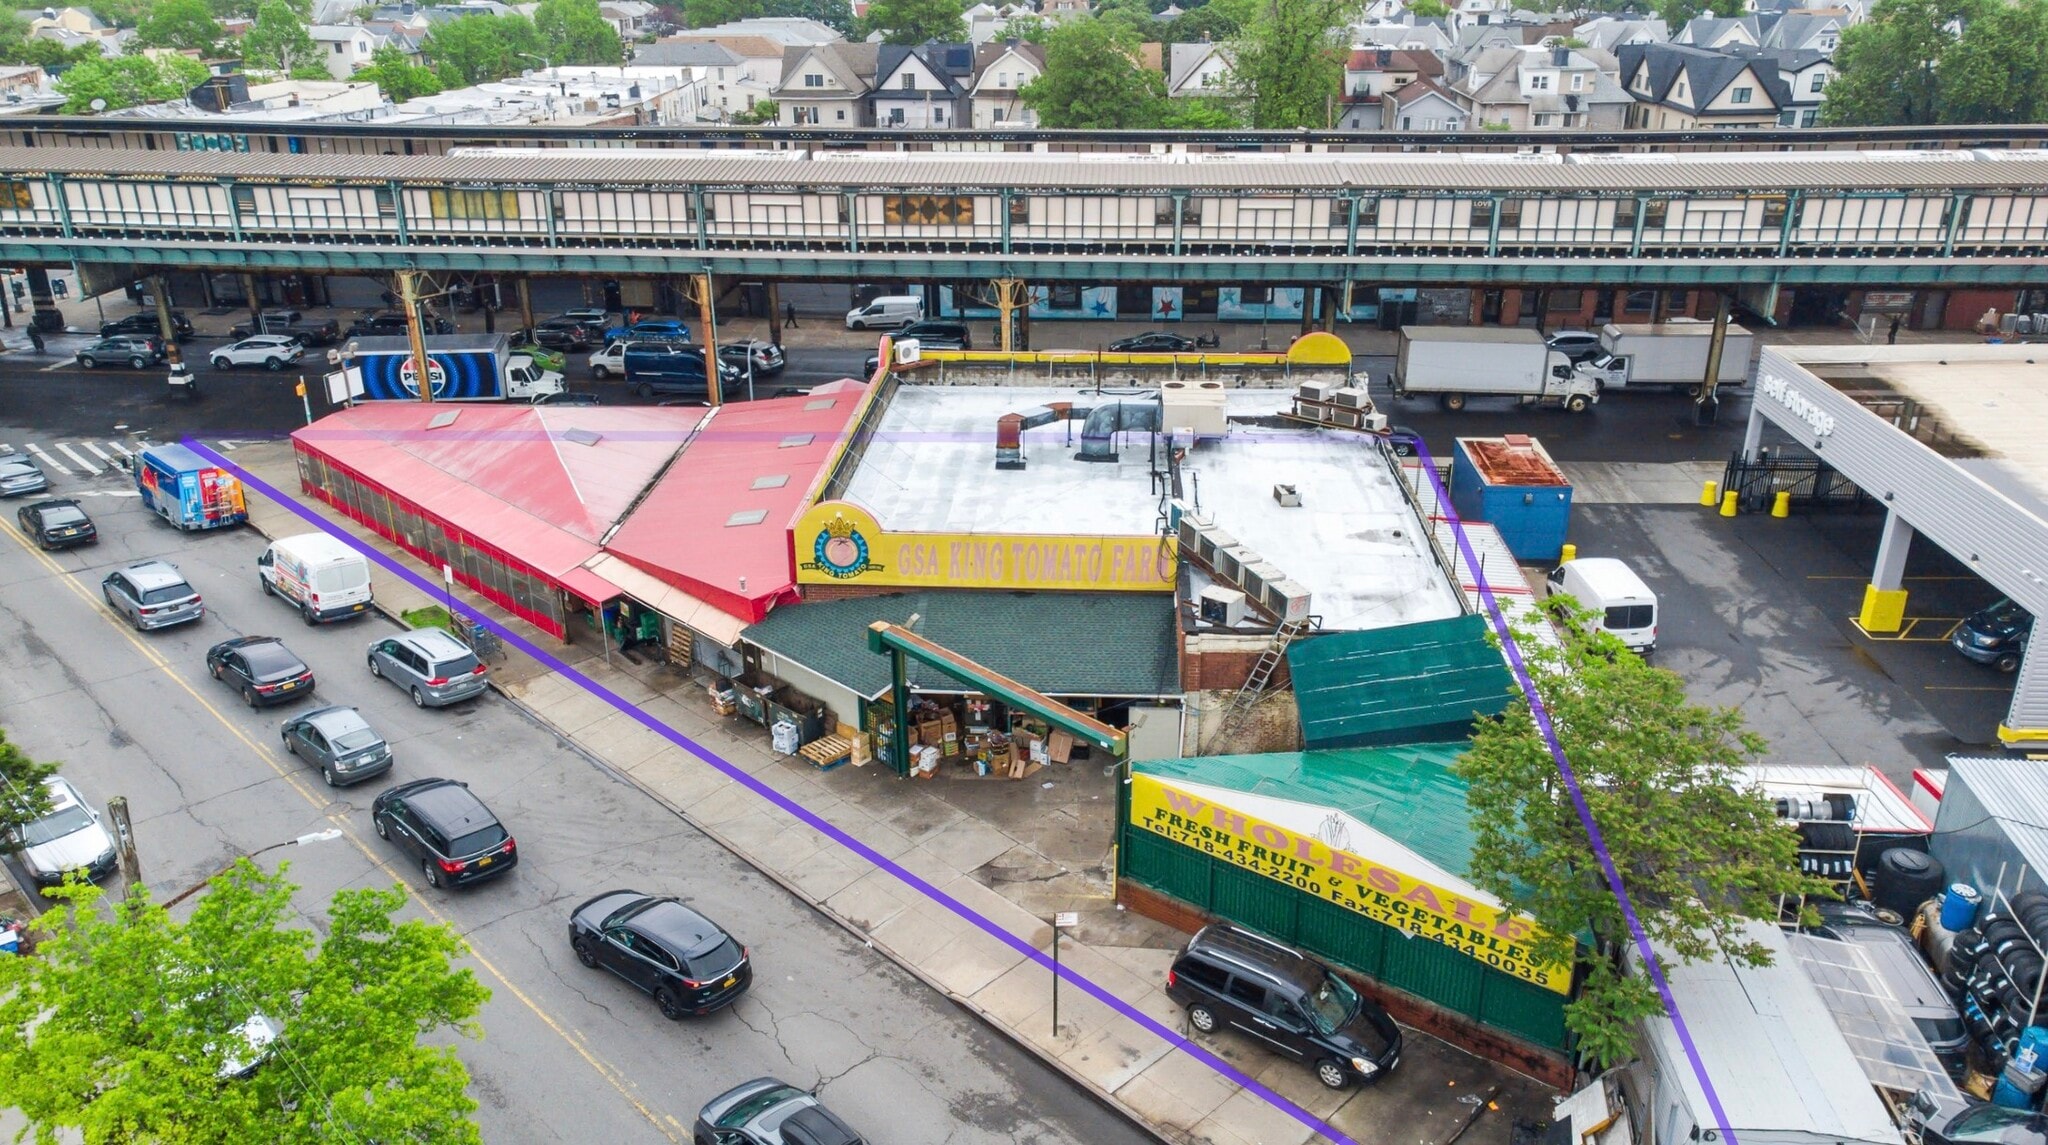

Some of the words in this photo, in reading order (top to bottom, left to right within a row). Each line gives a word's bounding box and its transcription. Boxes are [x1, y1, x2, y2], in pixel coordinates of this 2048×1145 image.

[403, 372, 443, 381] PESI
[1763, 374, 1789, 403] self
[1784, 390, 1835, 436] storage
[817, 561, 835, 577] KING
[838, 563, 867, 579] TOMATO
[898, 543, 939, 577] GSA
[948, 541, 1004, 580] KING
[1012, 543, 1103, 582] TOMATO
[1142, 816, 1322, 895] Tel:718-434-2200
[1161, 787, 1531, 944] WHOLESALE
[1154, 807, 1230, 847] FRESH
[1238, 838, 1316, 878] FRUIT
[1328, 875, 1344, 888] &
[1355, 884, 1544, 968] VEGETABLES
